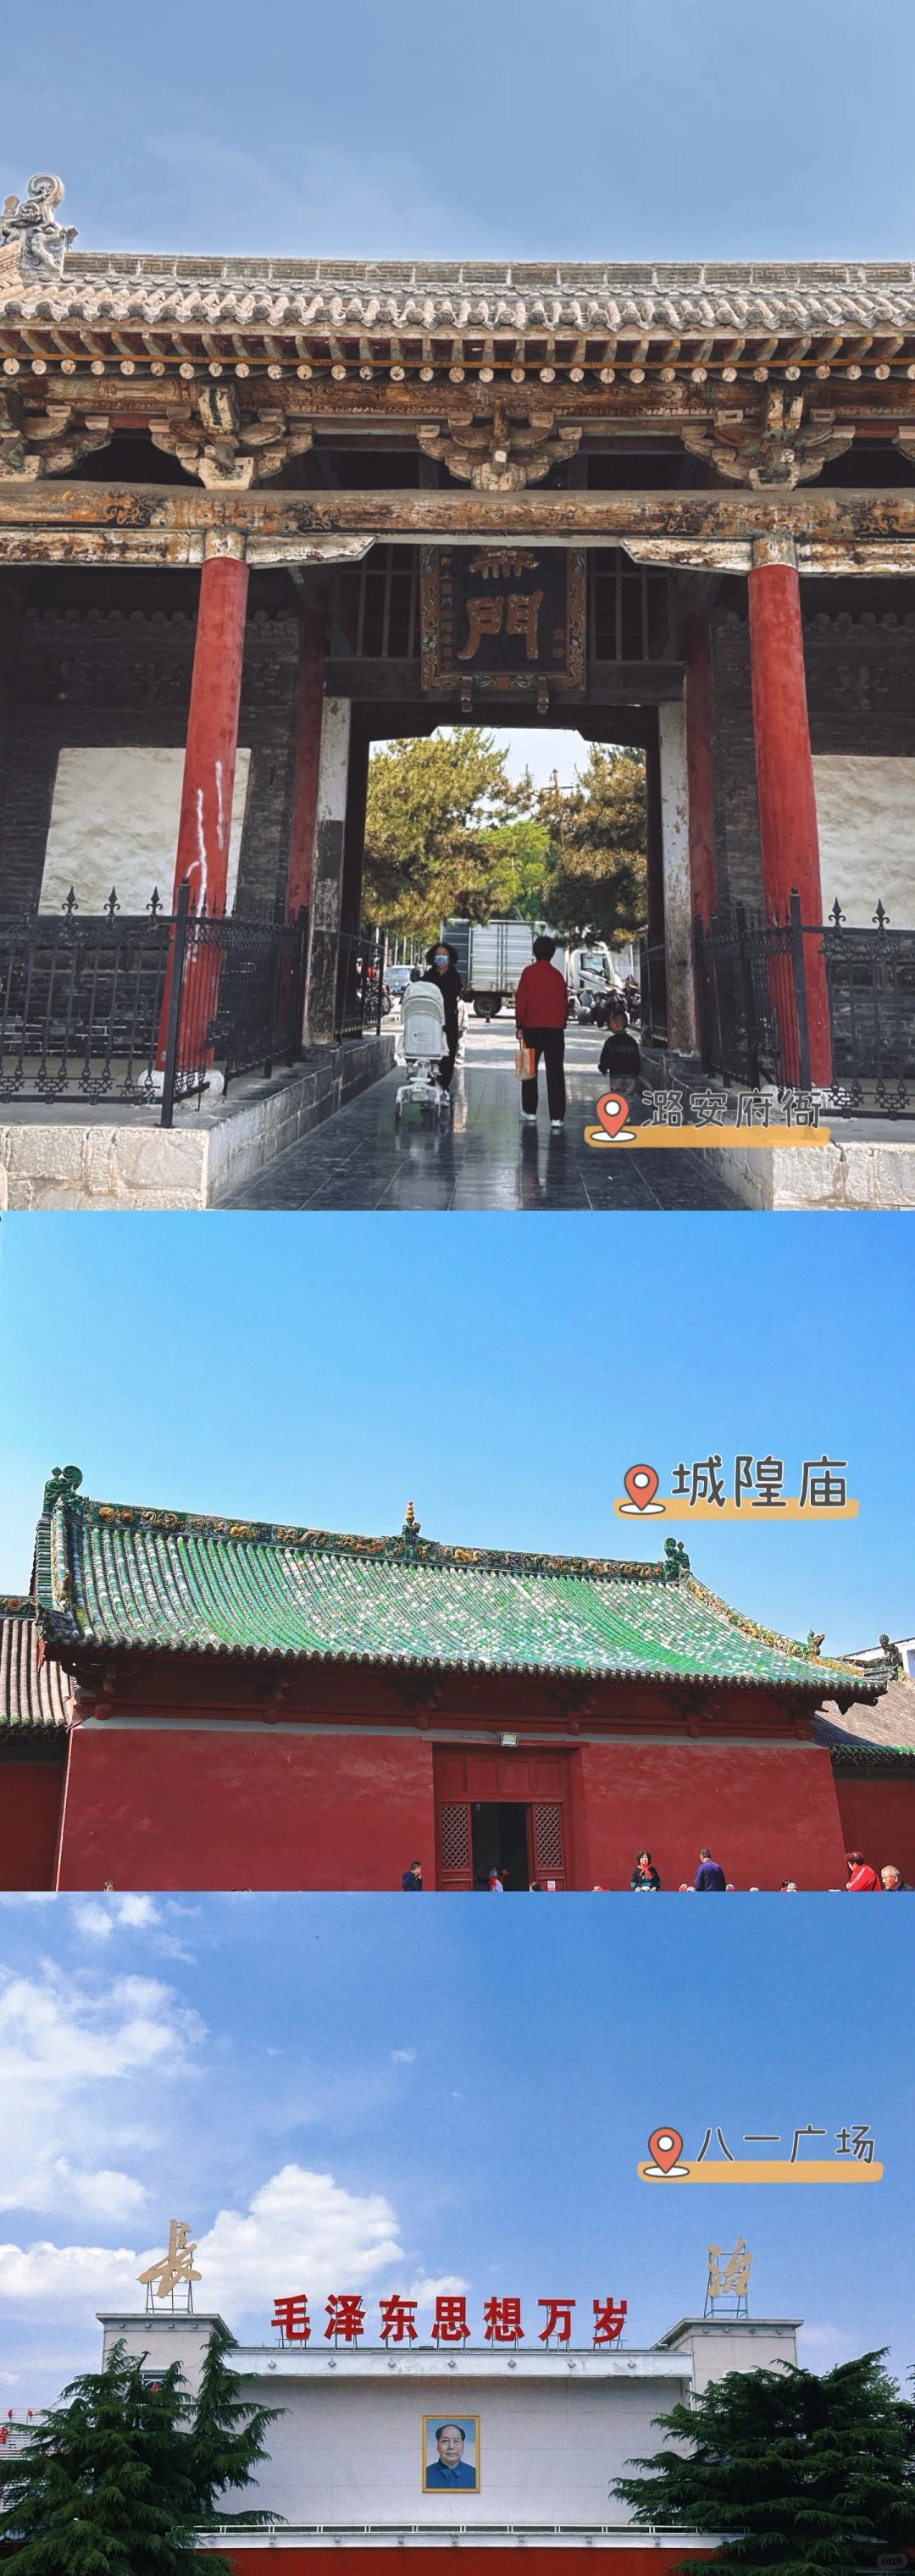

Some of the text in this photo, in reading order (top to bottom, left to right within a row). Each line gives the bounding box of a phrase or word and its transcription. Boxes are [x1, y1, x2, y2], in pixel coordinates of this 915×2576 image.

[270, 2293, 628, 2343] 毛泽东思想万岁
